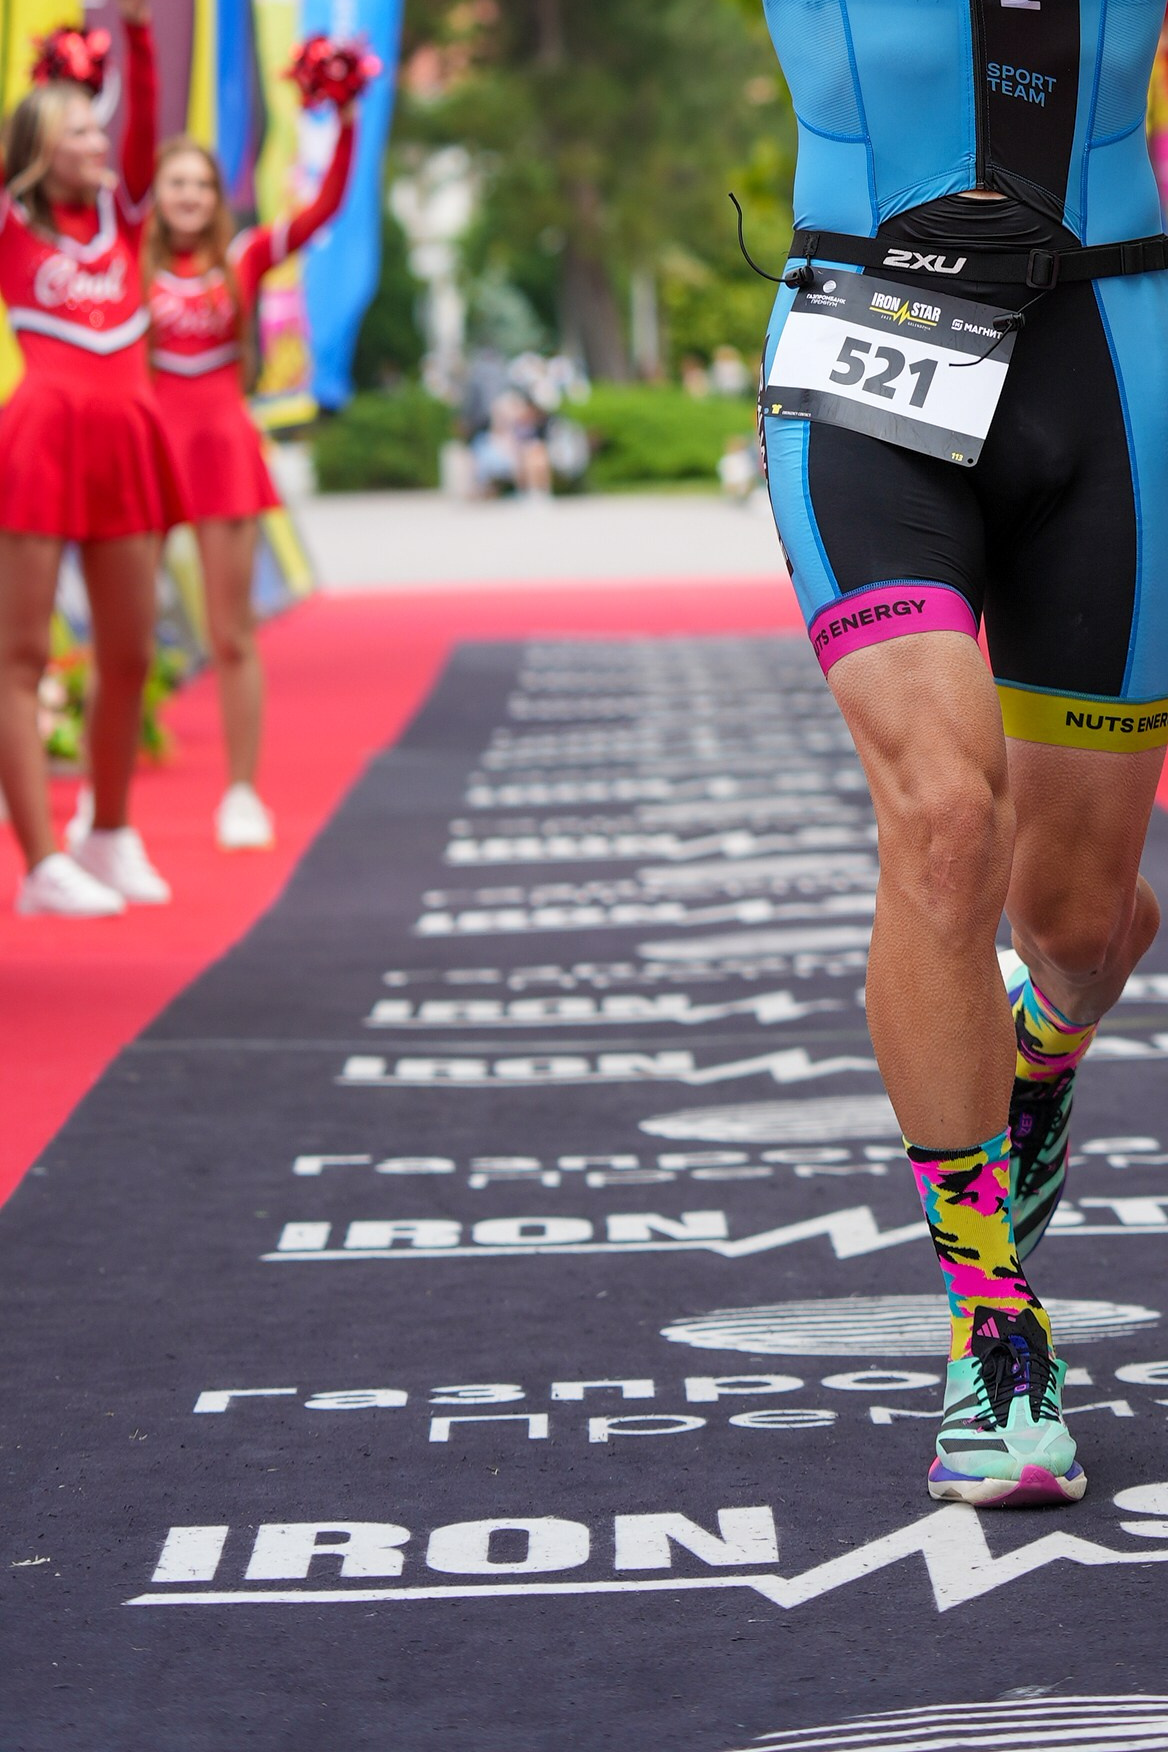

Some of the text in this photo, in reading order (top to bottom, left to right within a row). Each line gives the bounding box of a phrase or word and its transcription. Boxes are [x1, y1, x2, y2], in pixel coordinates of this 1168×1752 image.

[987, 62, 1057, 93] SPORT
[987, 77, 1046, 108] TEAM
[882, 248, 968, 275] 2XU
[871, 292, 942, 322] IRON STAR
[963, 322, 1003, 340] МАГНИТ
[828, 336, 938, 409] 521
[951, 452, 964, 462] 113
[829, 599, 926, 639] ENERGY
[1065, 710, 1135, 734] NUTS
[277, 1209, 731, 1250] IRON
[150, 1505, 780, 1583] IRON
